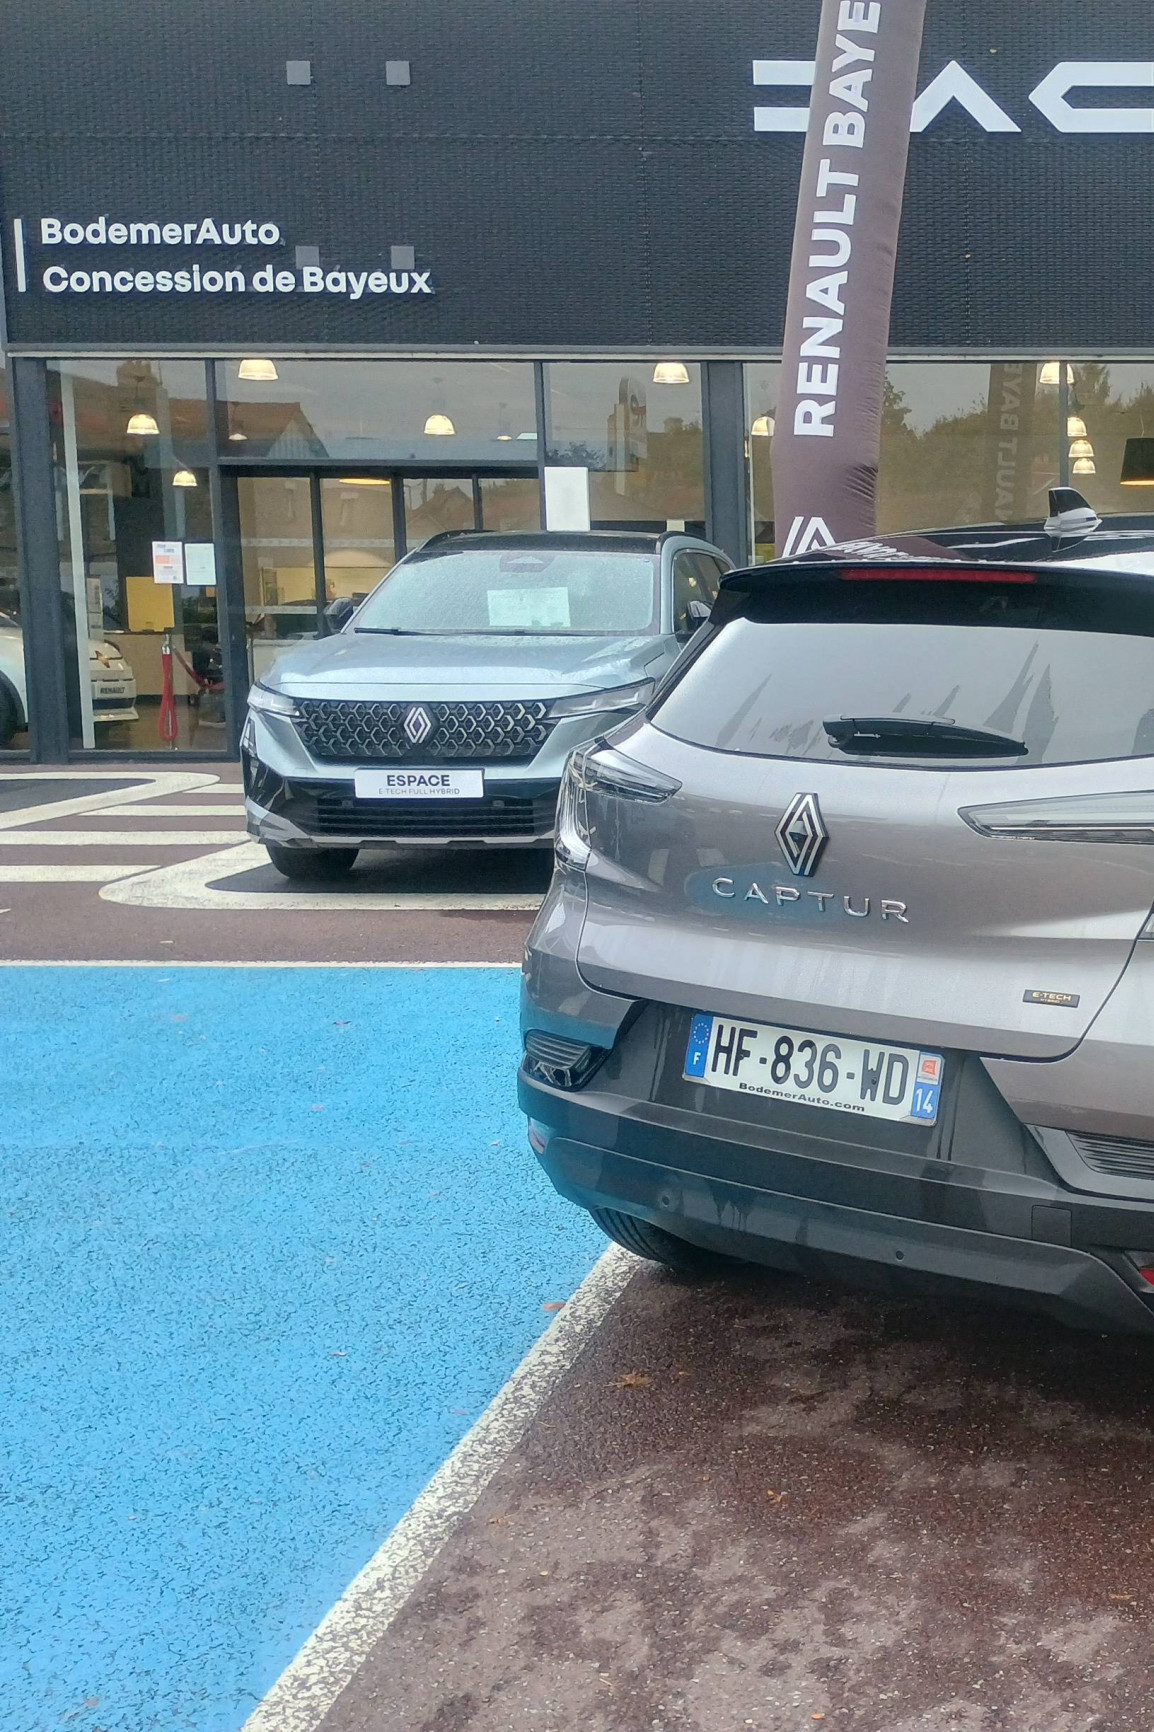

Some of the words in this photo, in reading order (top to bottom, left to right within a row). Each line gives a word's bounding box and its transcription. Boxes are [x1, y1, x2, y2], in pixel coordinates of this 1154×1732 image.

[41, 216, 281, 245] BodemerAuto
[42, 265, 247, 294] Concession
[252, 265, 296, 294] de
[303, 266, 432, 300] Bayeux
[793, 159, 859, 437] RENAULT
[386, 774, 451, 787] ESPACE
[429, 787, 460, 795] HYBRID
[711, 877, 910, 924] CAPTUR
[692, 1051, 702, 1066] F
[711, 1023, 910, 1106] HF-836-WD
[915, 1087, 934, 1114] 14
[738, 1082, 866, 1113] BodemerAuto.com
